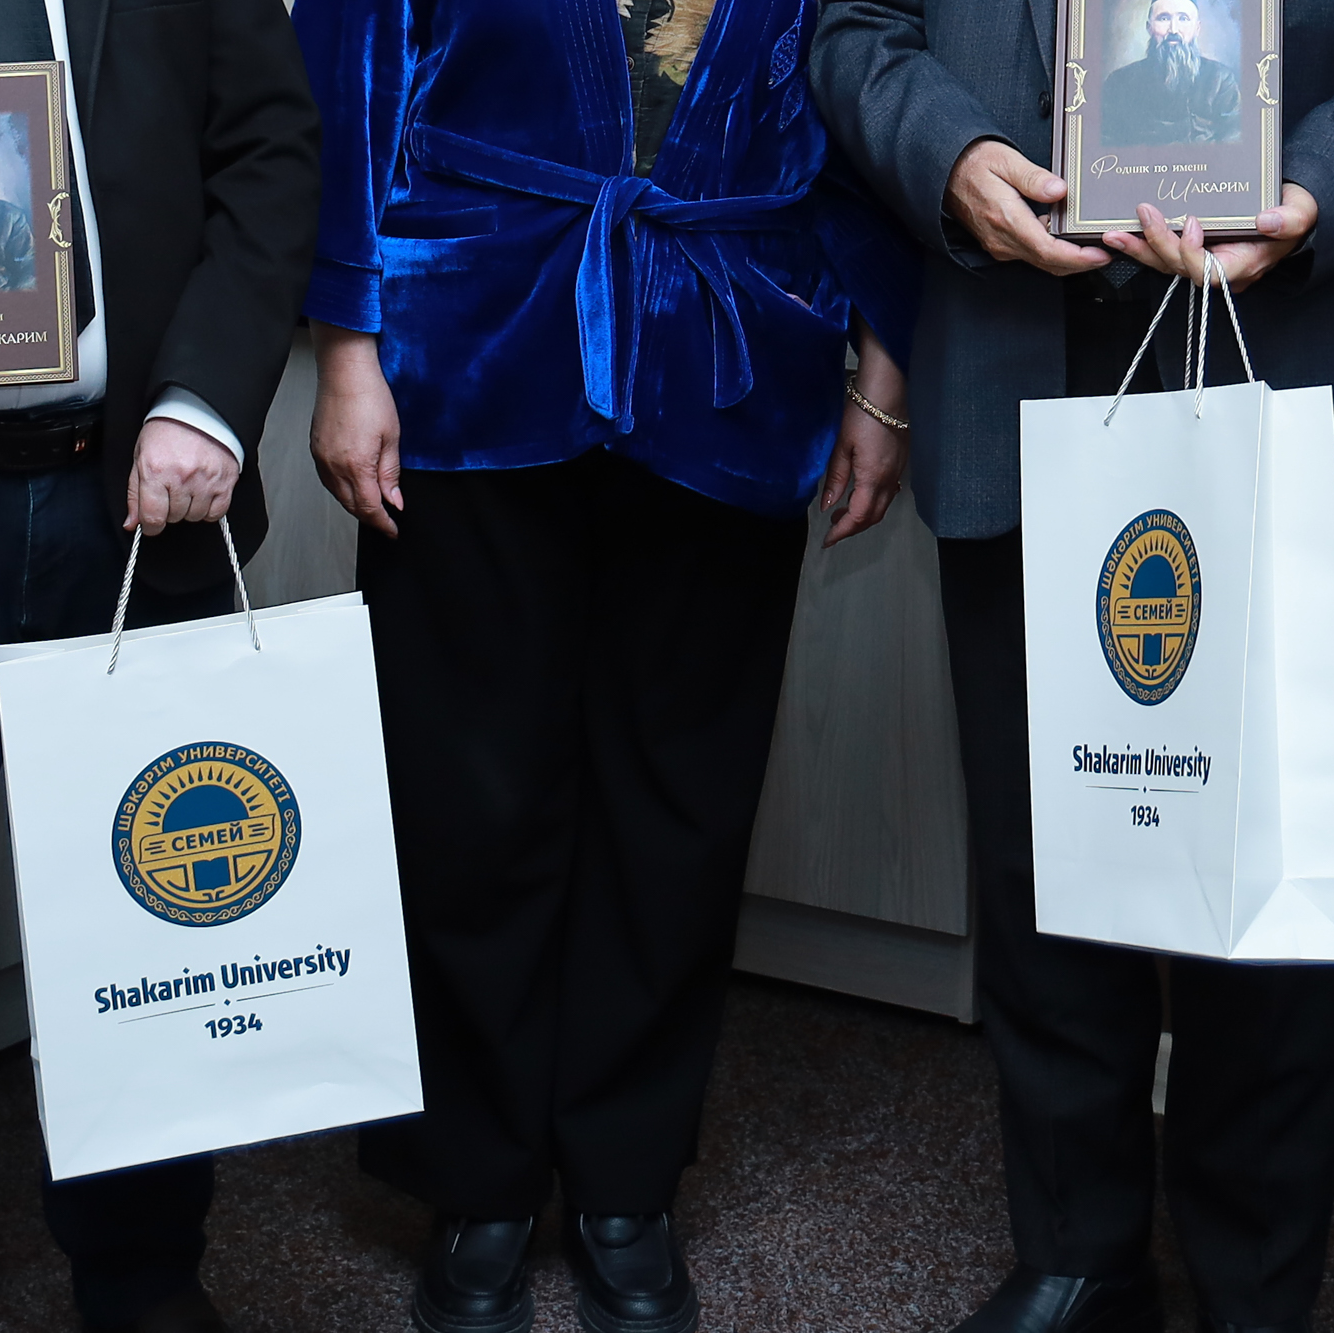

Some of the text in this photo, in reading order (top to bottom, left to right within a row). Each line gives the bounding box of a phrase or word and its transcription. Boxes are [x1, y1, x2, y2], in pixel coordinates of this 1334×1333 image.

[1090, 154, 1207, 179] Родник по имени
[1157, 177, 1249, 203] ШАКАРИМ
[1101, 513, 1199, 590] ШӘКӘРІМ УНИВЕРСИТЕТІ
[1134, 599, 1172, 621] СЕМЕЙ
[1073, 743, 1211, 785] Shakarim University
[118, 745, 291, 831] ШӘКӘРІМ УНИВЕРСИТЕТІ
[1130, 805, 1160, 827] 1934
[171, 821, 243, 852] СЕМЕЙ
[94, 943, 351, 1013] Shakarim University
[205, 1013, 262, 1039] 1934
